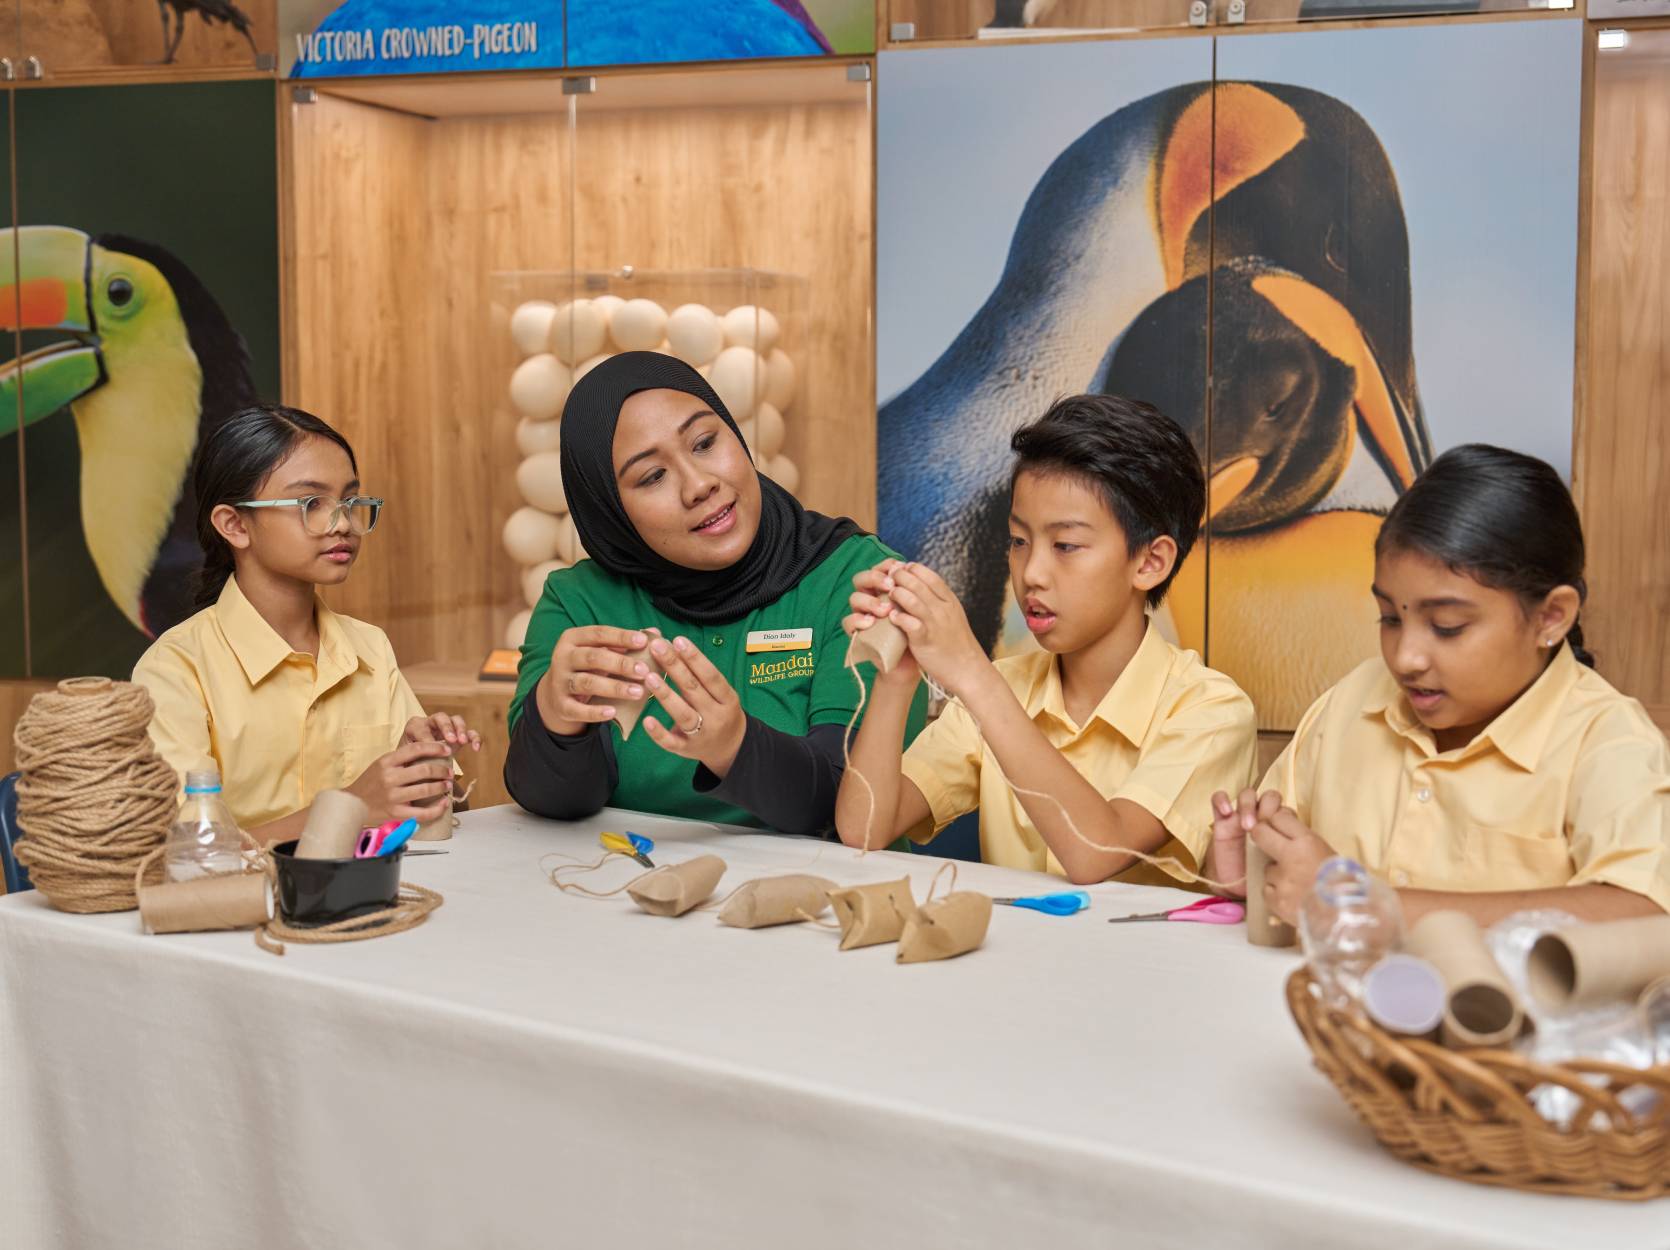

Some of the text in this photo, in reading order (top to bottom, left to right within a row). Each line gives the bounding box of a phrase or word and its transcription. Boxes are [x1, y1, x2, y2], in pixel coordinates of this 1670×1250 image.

[296, 21, 537, 64] VICTORIA CROWNED-PIGEON
[749, 668, 815, 685] WILDLIFE GROUP
[751, 652, 815, 677] Mandai
